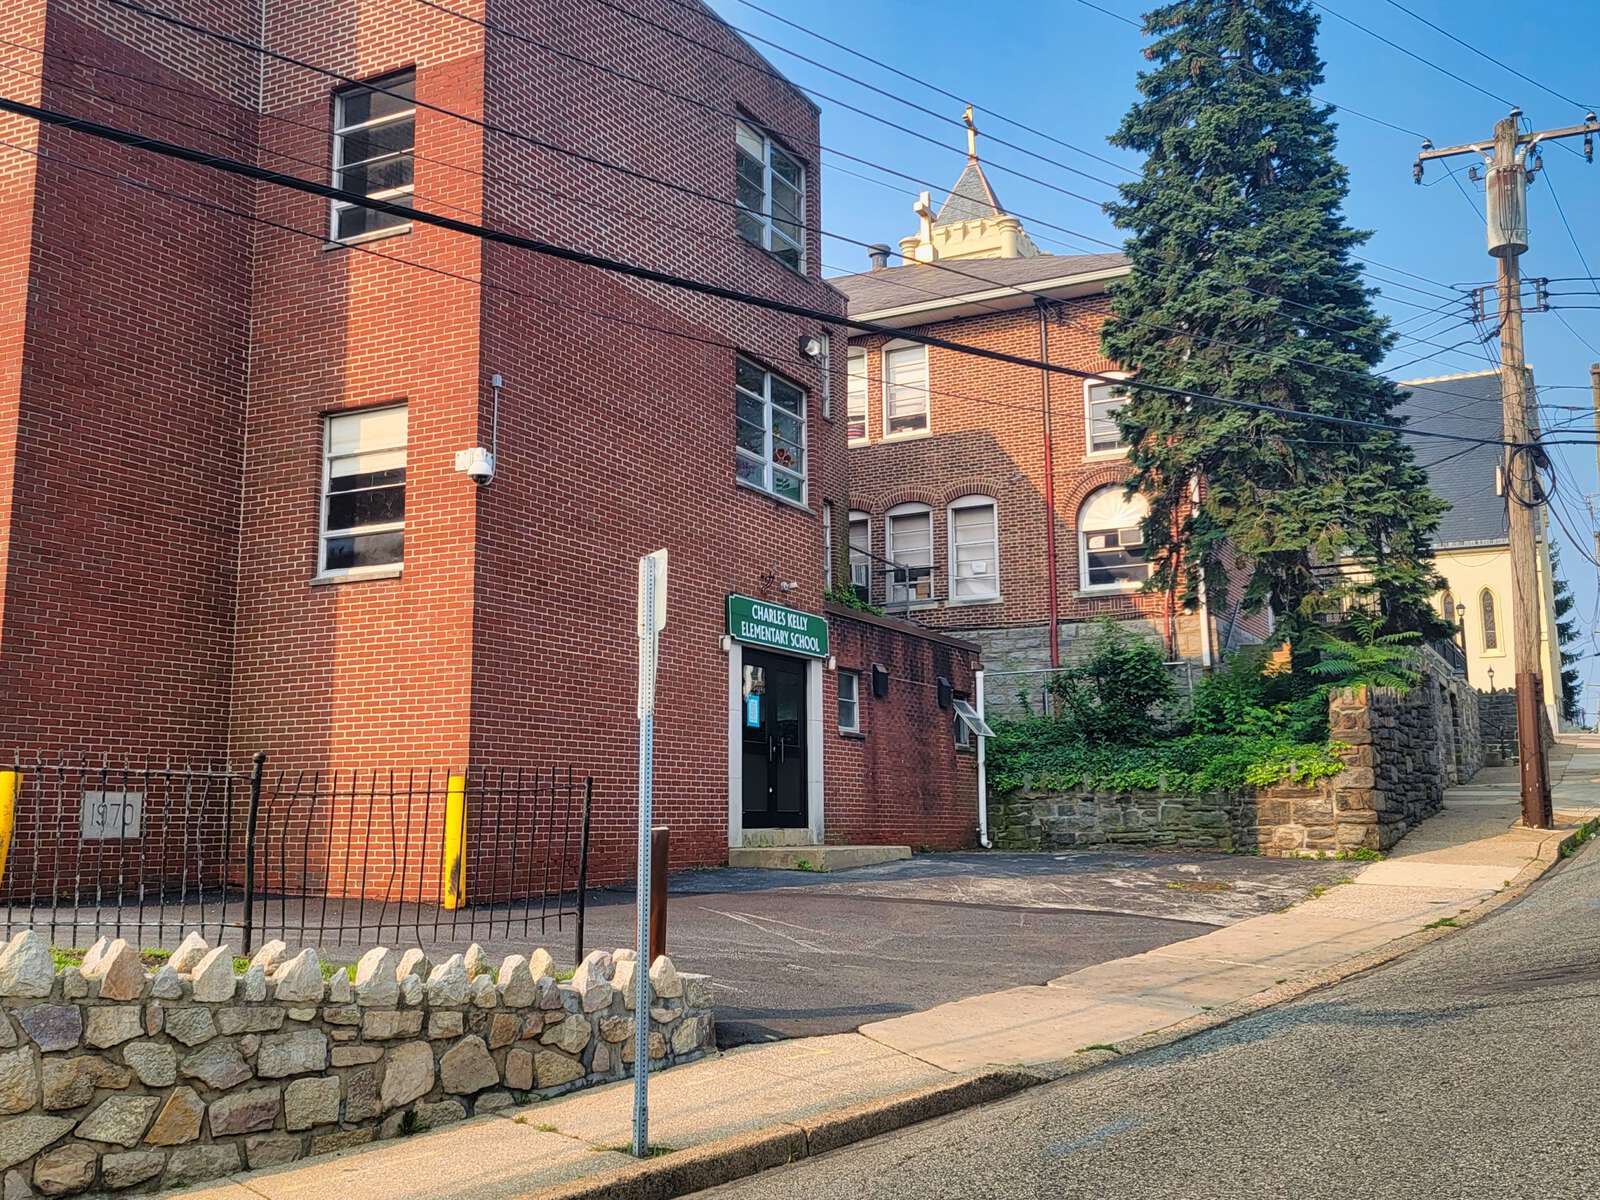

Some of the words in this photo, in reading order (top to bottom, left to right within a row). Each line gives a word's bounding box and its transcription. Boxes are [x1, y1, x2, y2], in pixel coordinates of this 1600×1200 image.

[752, 605, 786, 626] CHARLES
[787, 614, 808, 631] KELLY
[741, 621, 789, 645] ELEMENTARY
[790, 632, 820, 652] SCHOOL
[91, 803, 134, 826] 1970
